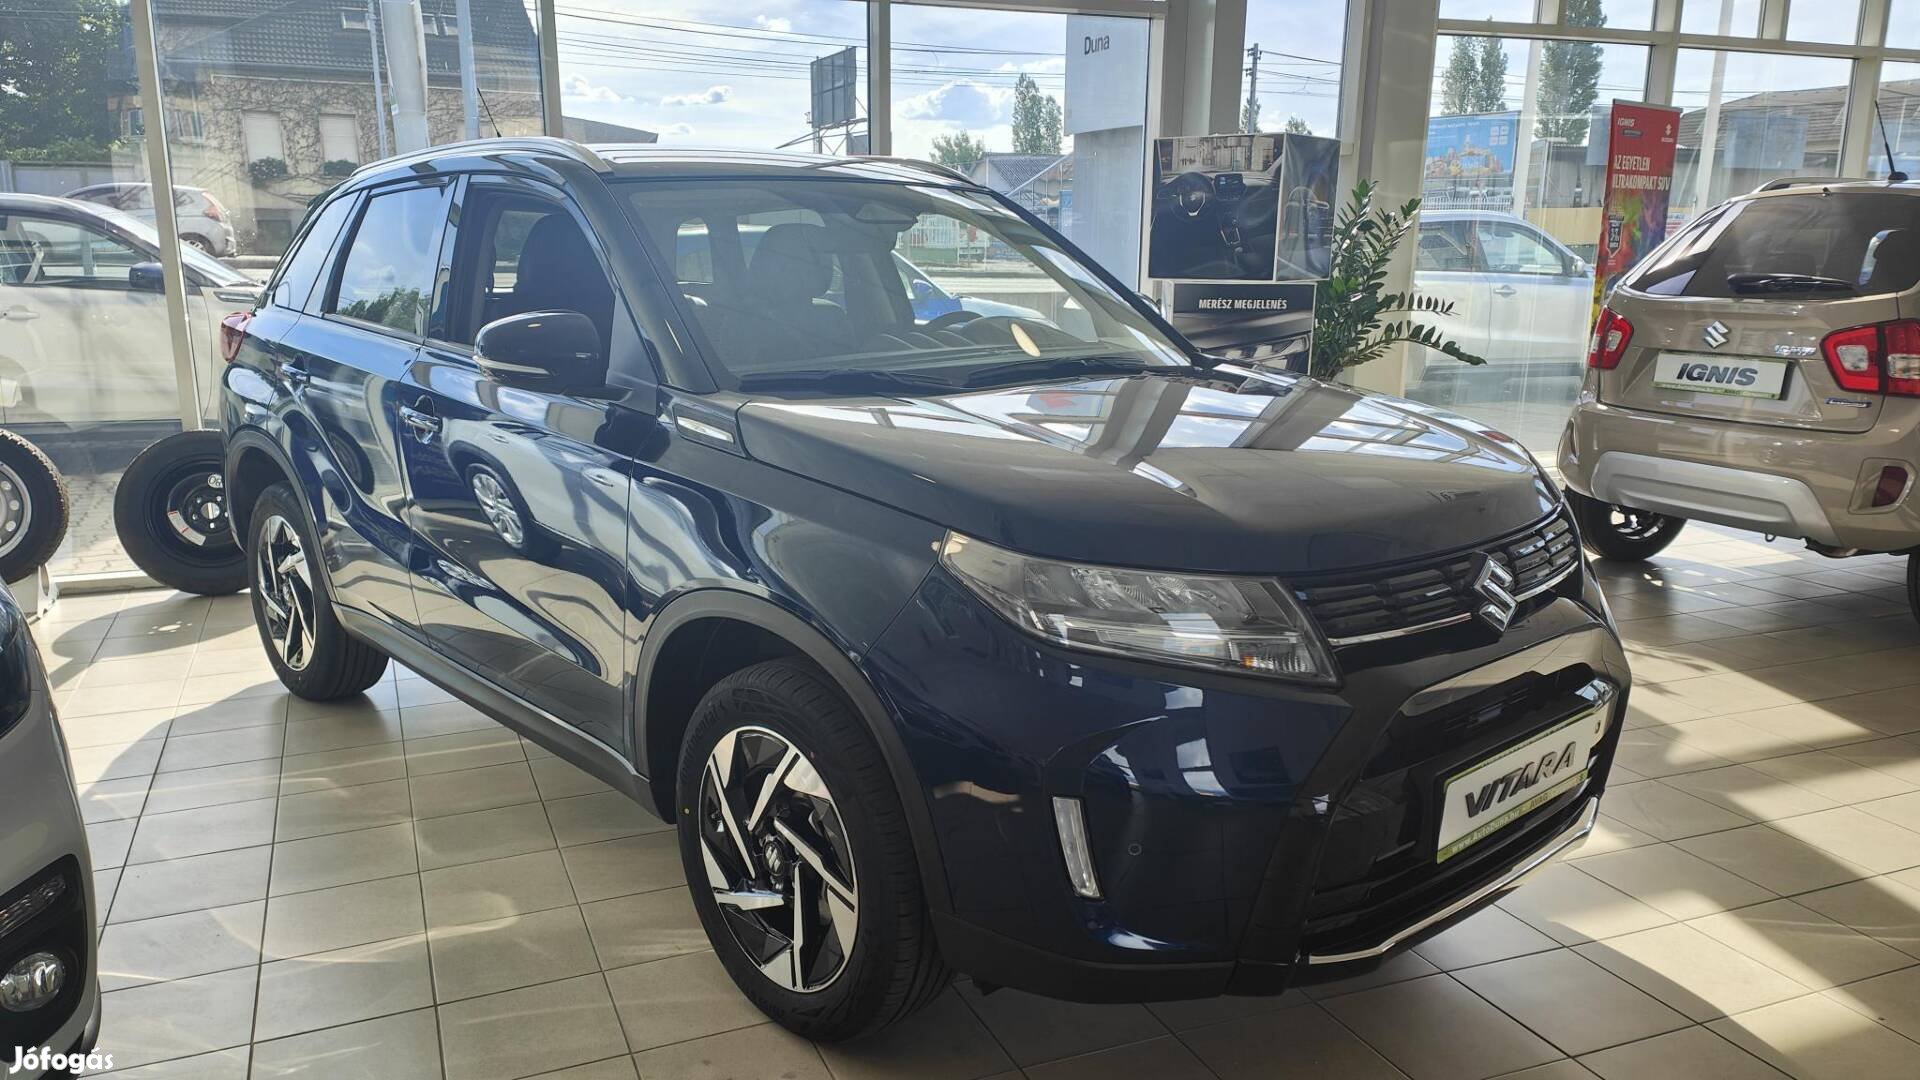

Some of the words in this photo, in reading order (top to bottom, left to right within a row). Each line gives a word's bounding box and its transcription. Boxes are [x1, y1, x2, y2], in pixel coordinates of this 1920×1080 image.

[1084, 35, 1110, 56] Duna
[1622, 155, 1651, 171] EGYETLEN
[1658, 175, 1671, 191] SUV
[1198, 297, 1232, 309] MERÉSZ
[1234, 297, 1288, 310] MEGJELENÉS
[1676, 362, 1758, 386] IGNIS
[1465, 741, 1576, 818] VITARA
